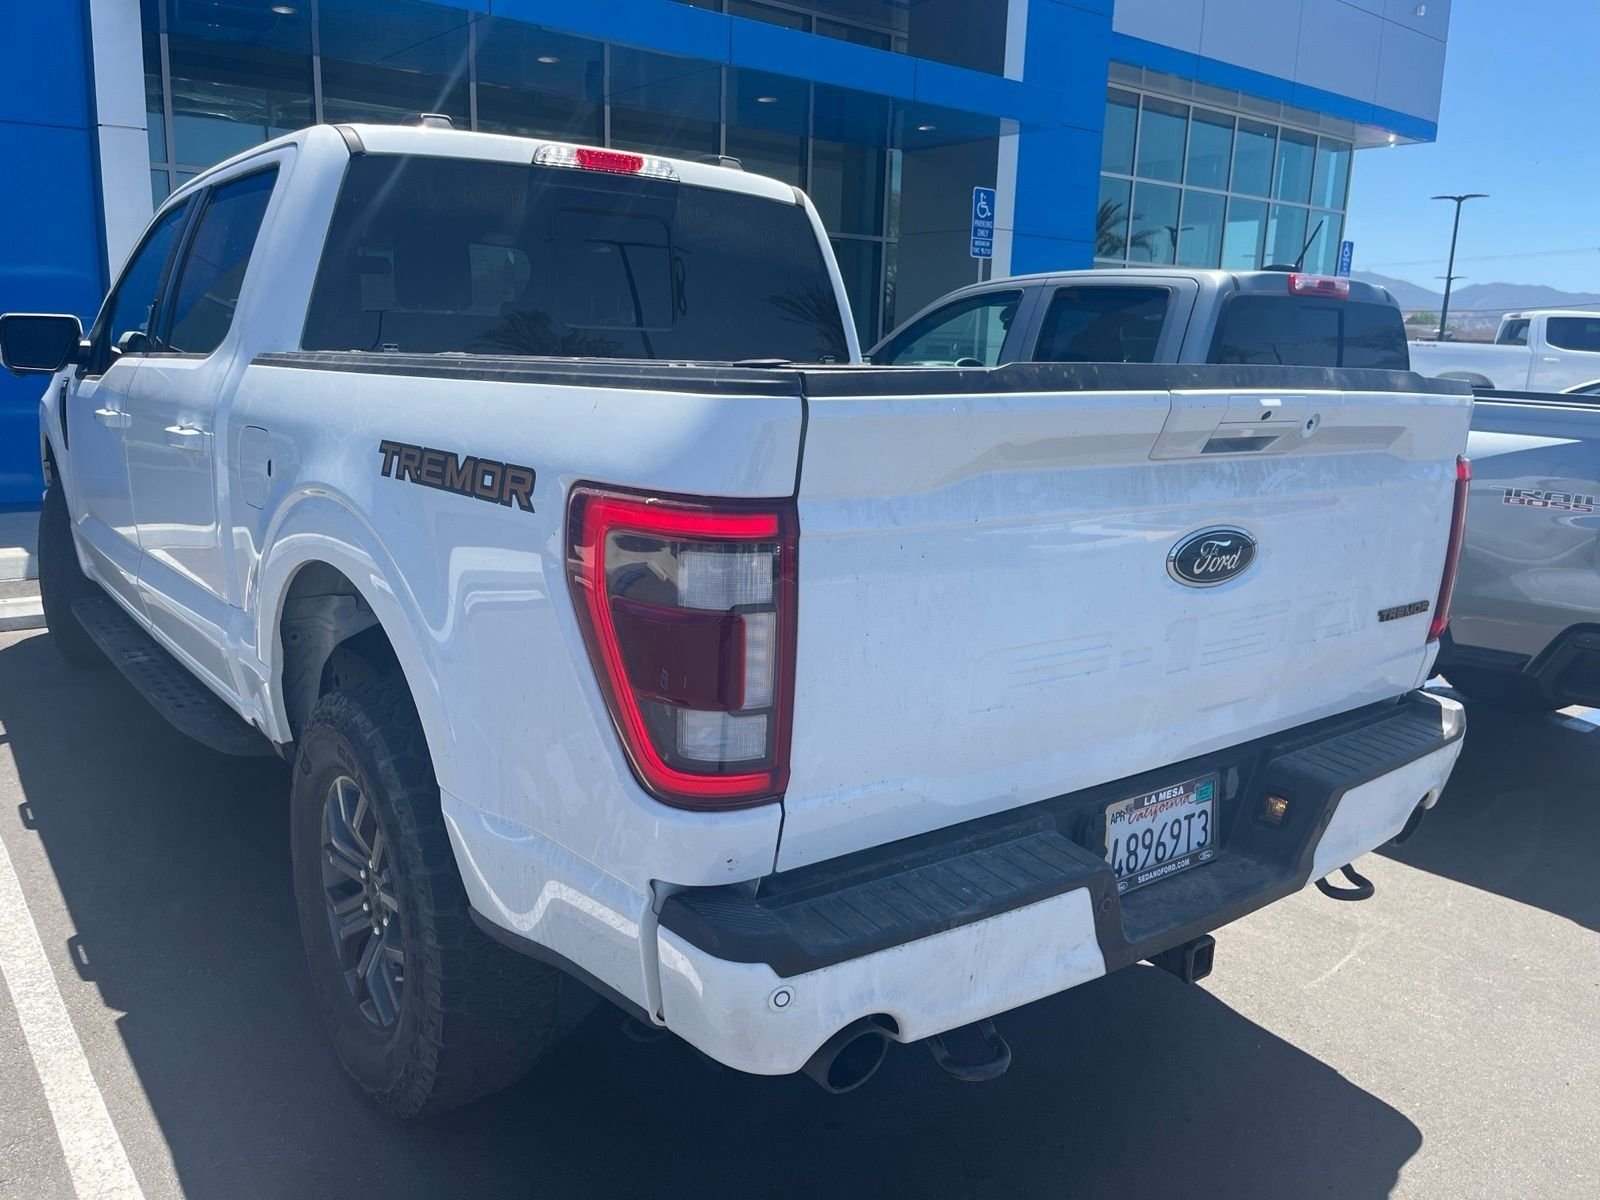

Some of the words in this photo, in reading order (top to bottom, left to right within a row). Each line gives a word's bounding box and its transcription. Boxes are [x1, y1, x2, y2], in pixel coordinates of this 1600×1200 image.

[974, 219, 993, 229] PARKING
[379, 440, 537, 514] TREMOR
[1503, 496, 1593, 513] BOSS
[1193, 540, 1241, 574] Ford
[1378, 600, 1430, 622] TREMOR
[1143, 795, 1157, 806] LA
[1158, 786, 1184, 802] MESA
[1110, 810, 1125, 825] APR
[1128, 795, 1192, 824] California
[1111, 809, 1209, 879] 48969T3
[1138, 858, 1190, 883] SEDANOFORD.COM
